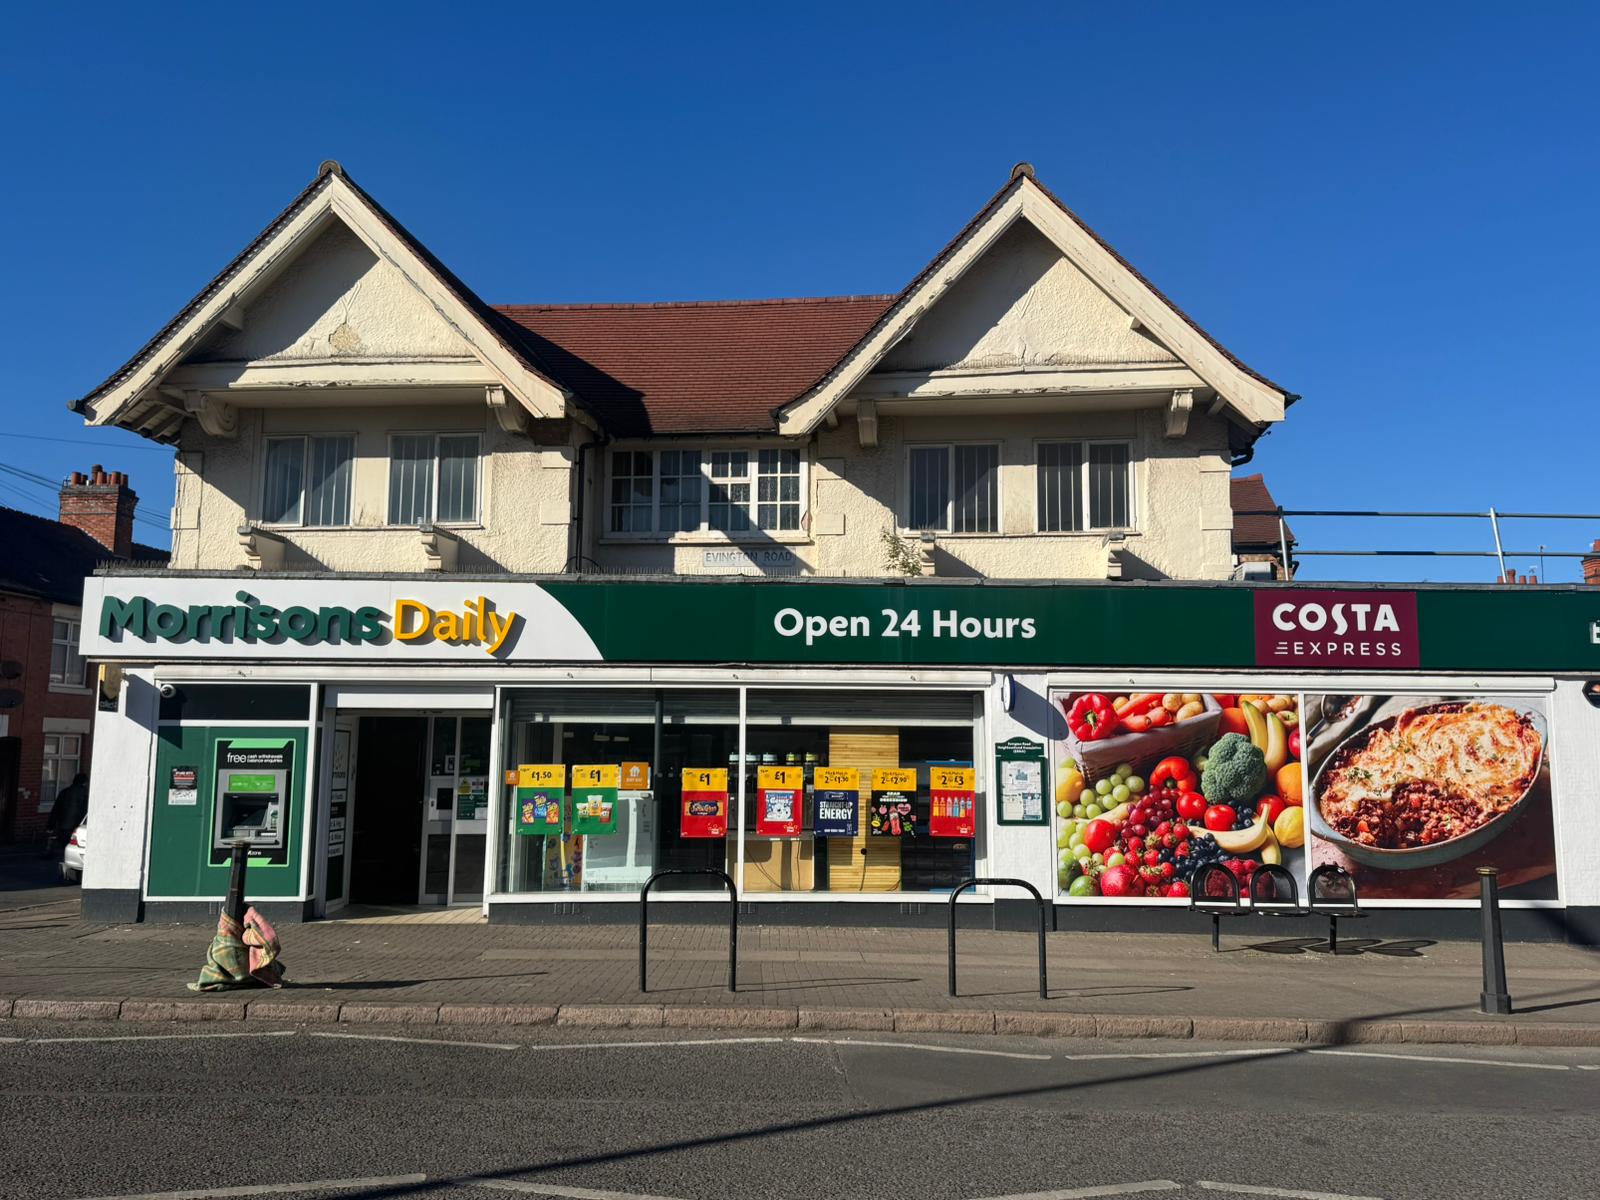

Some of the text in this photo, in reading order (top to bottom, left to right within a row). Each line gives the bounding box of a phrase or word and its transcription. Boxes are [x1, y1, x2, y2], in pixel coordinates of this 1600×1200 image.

[705, 552, 792, 562] EVINGTON ROAD
[99, 590, 517, 655] Morrisons Daily
[1272, 602, 1401, 636] COSTA
[773, 607, 1037, 646] Open 24 Hours
[1293, 641, 1402, 656] EXPRESS
[227, 752, 247, 763] free
[531, 771, 552, 781] £1.50
[590, 769, 601, 783] £1
[700, 773, 710, 786] £1
[774, 771, 786, 784] £1
[824, 775, 830, 783] 2
[880, 776, 886, 784] 2
[941, 775, 947, 785] 2
[954, 775, 964, 786] £3
[819, 808, 853, 820] ENERGY
